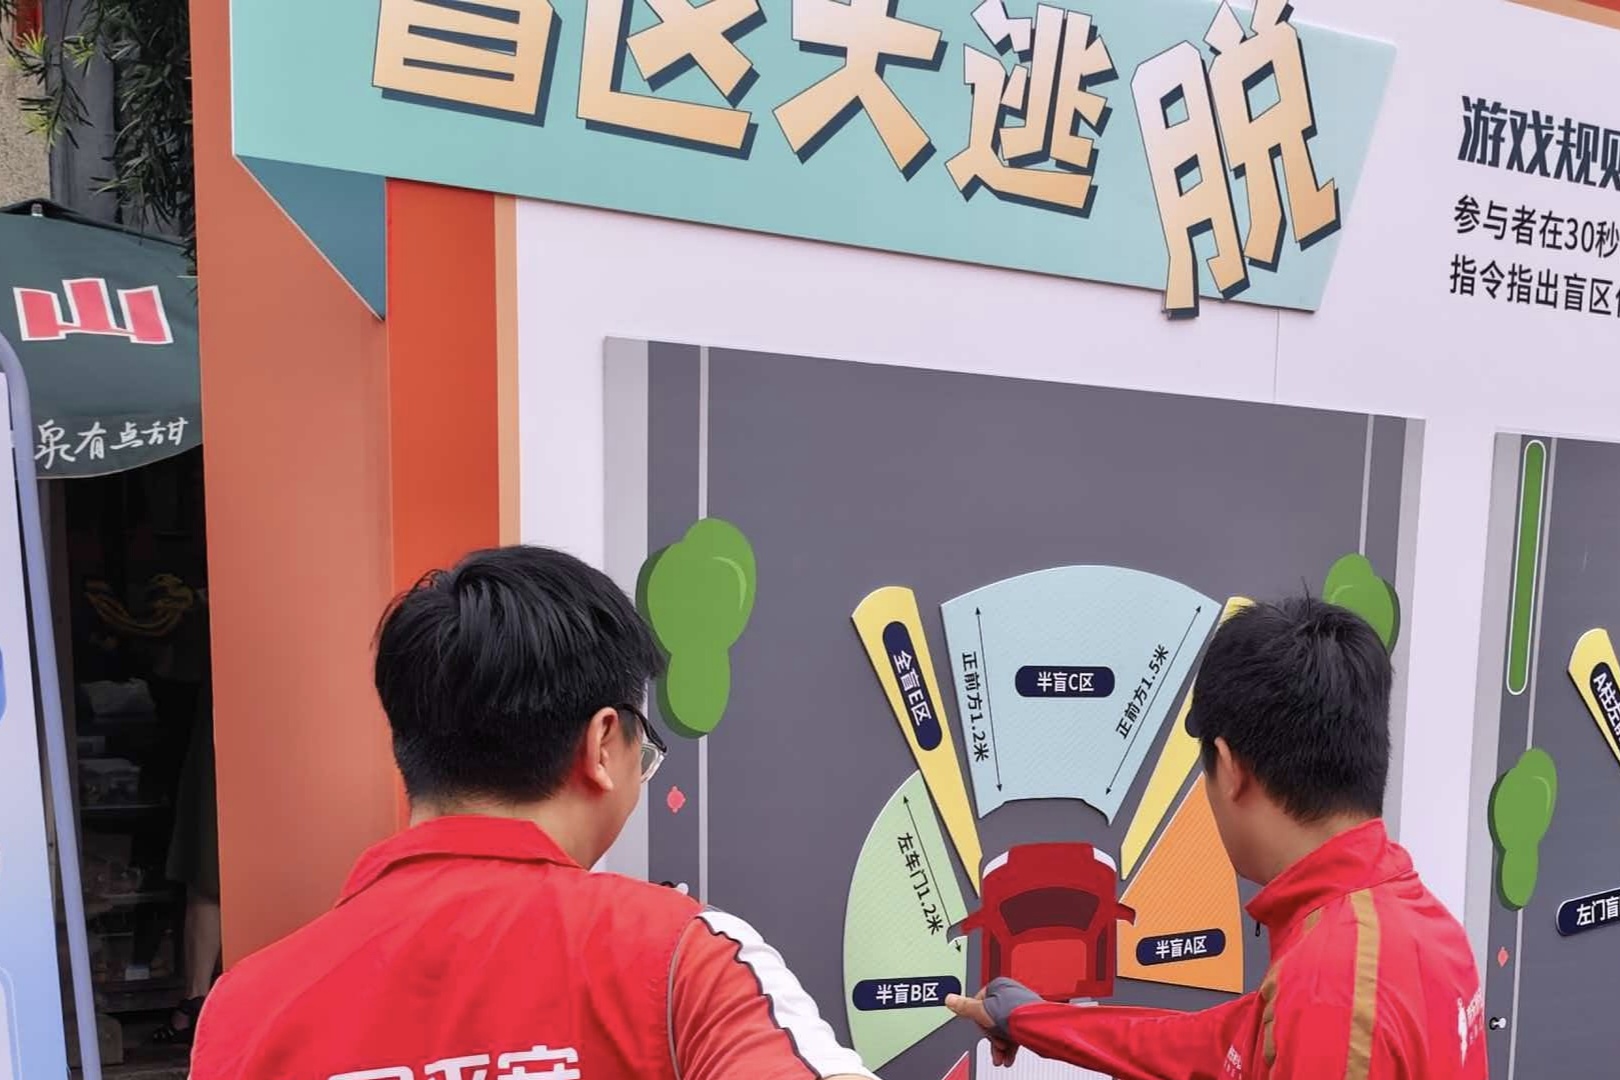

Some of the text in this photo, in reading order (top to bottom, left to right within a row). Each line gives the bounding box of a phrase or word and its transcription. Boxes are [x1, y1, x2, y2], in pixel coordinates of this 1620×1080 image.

[34, 417, 189, 469] 泉有点甜
[894, 649, 932, 726] 全盲E区
[961, 651, 990, 763] 正前方1.2米
[1036, 671, 1095, 693] 半盲C区
[1115, 643, 1170, 740] 正前方1.5米
[896, 832, 945, 935] 左车门1.2米
[1155, 935, 1207, 959] 半盲A区
[875, 982, 939, 1004] 半盲B区
